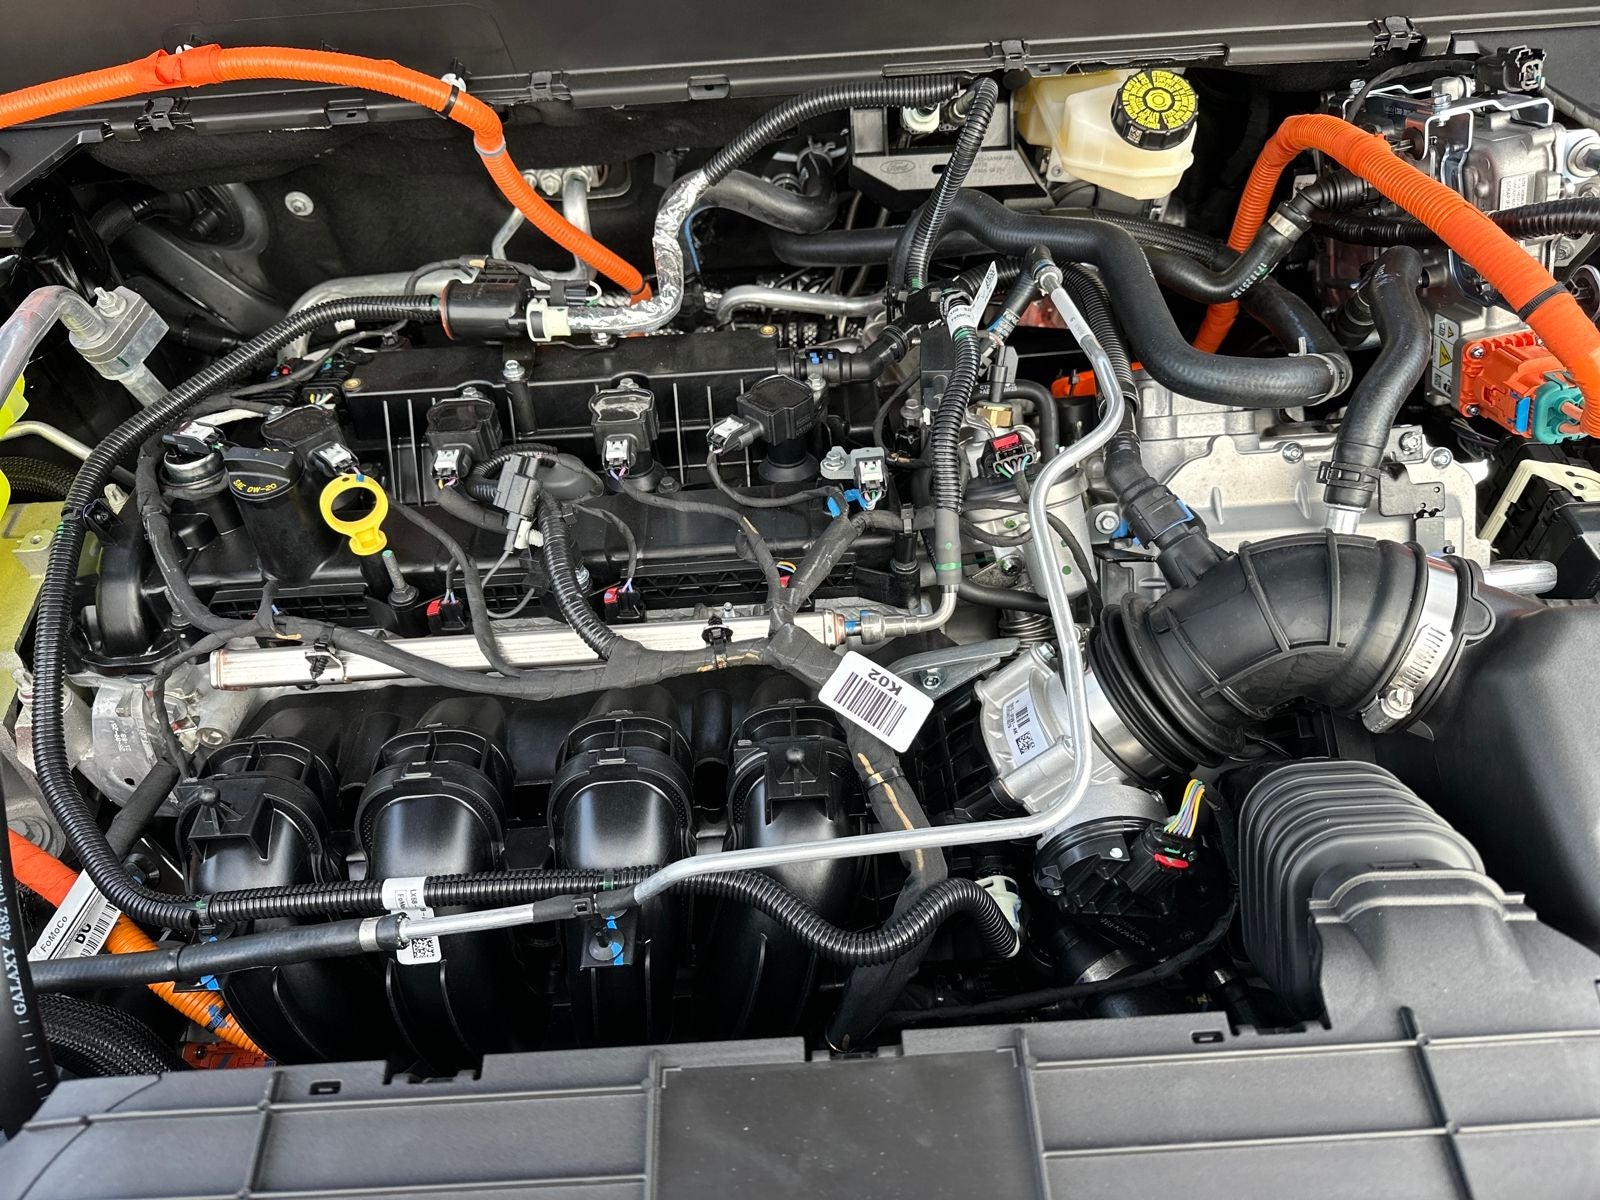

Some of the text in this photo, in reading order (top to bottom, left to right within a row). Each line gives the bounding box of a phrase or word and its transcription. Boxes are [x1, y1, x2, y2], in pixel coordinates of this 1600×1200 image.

[232, 479, 247, 491] SAE
[867, 667, 903, 697] K02
[40, 915, 68, 953] FoMoCo
[3, 946, 27, 1016] GALAXY
